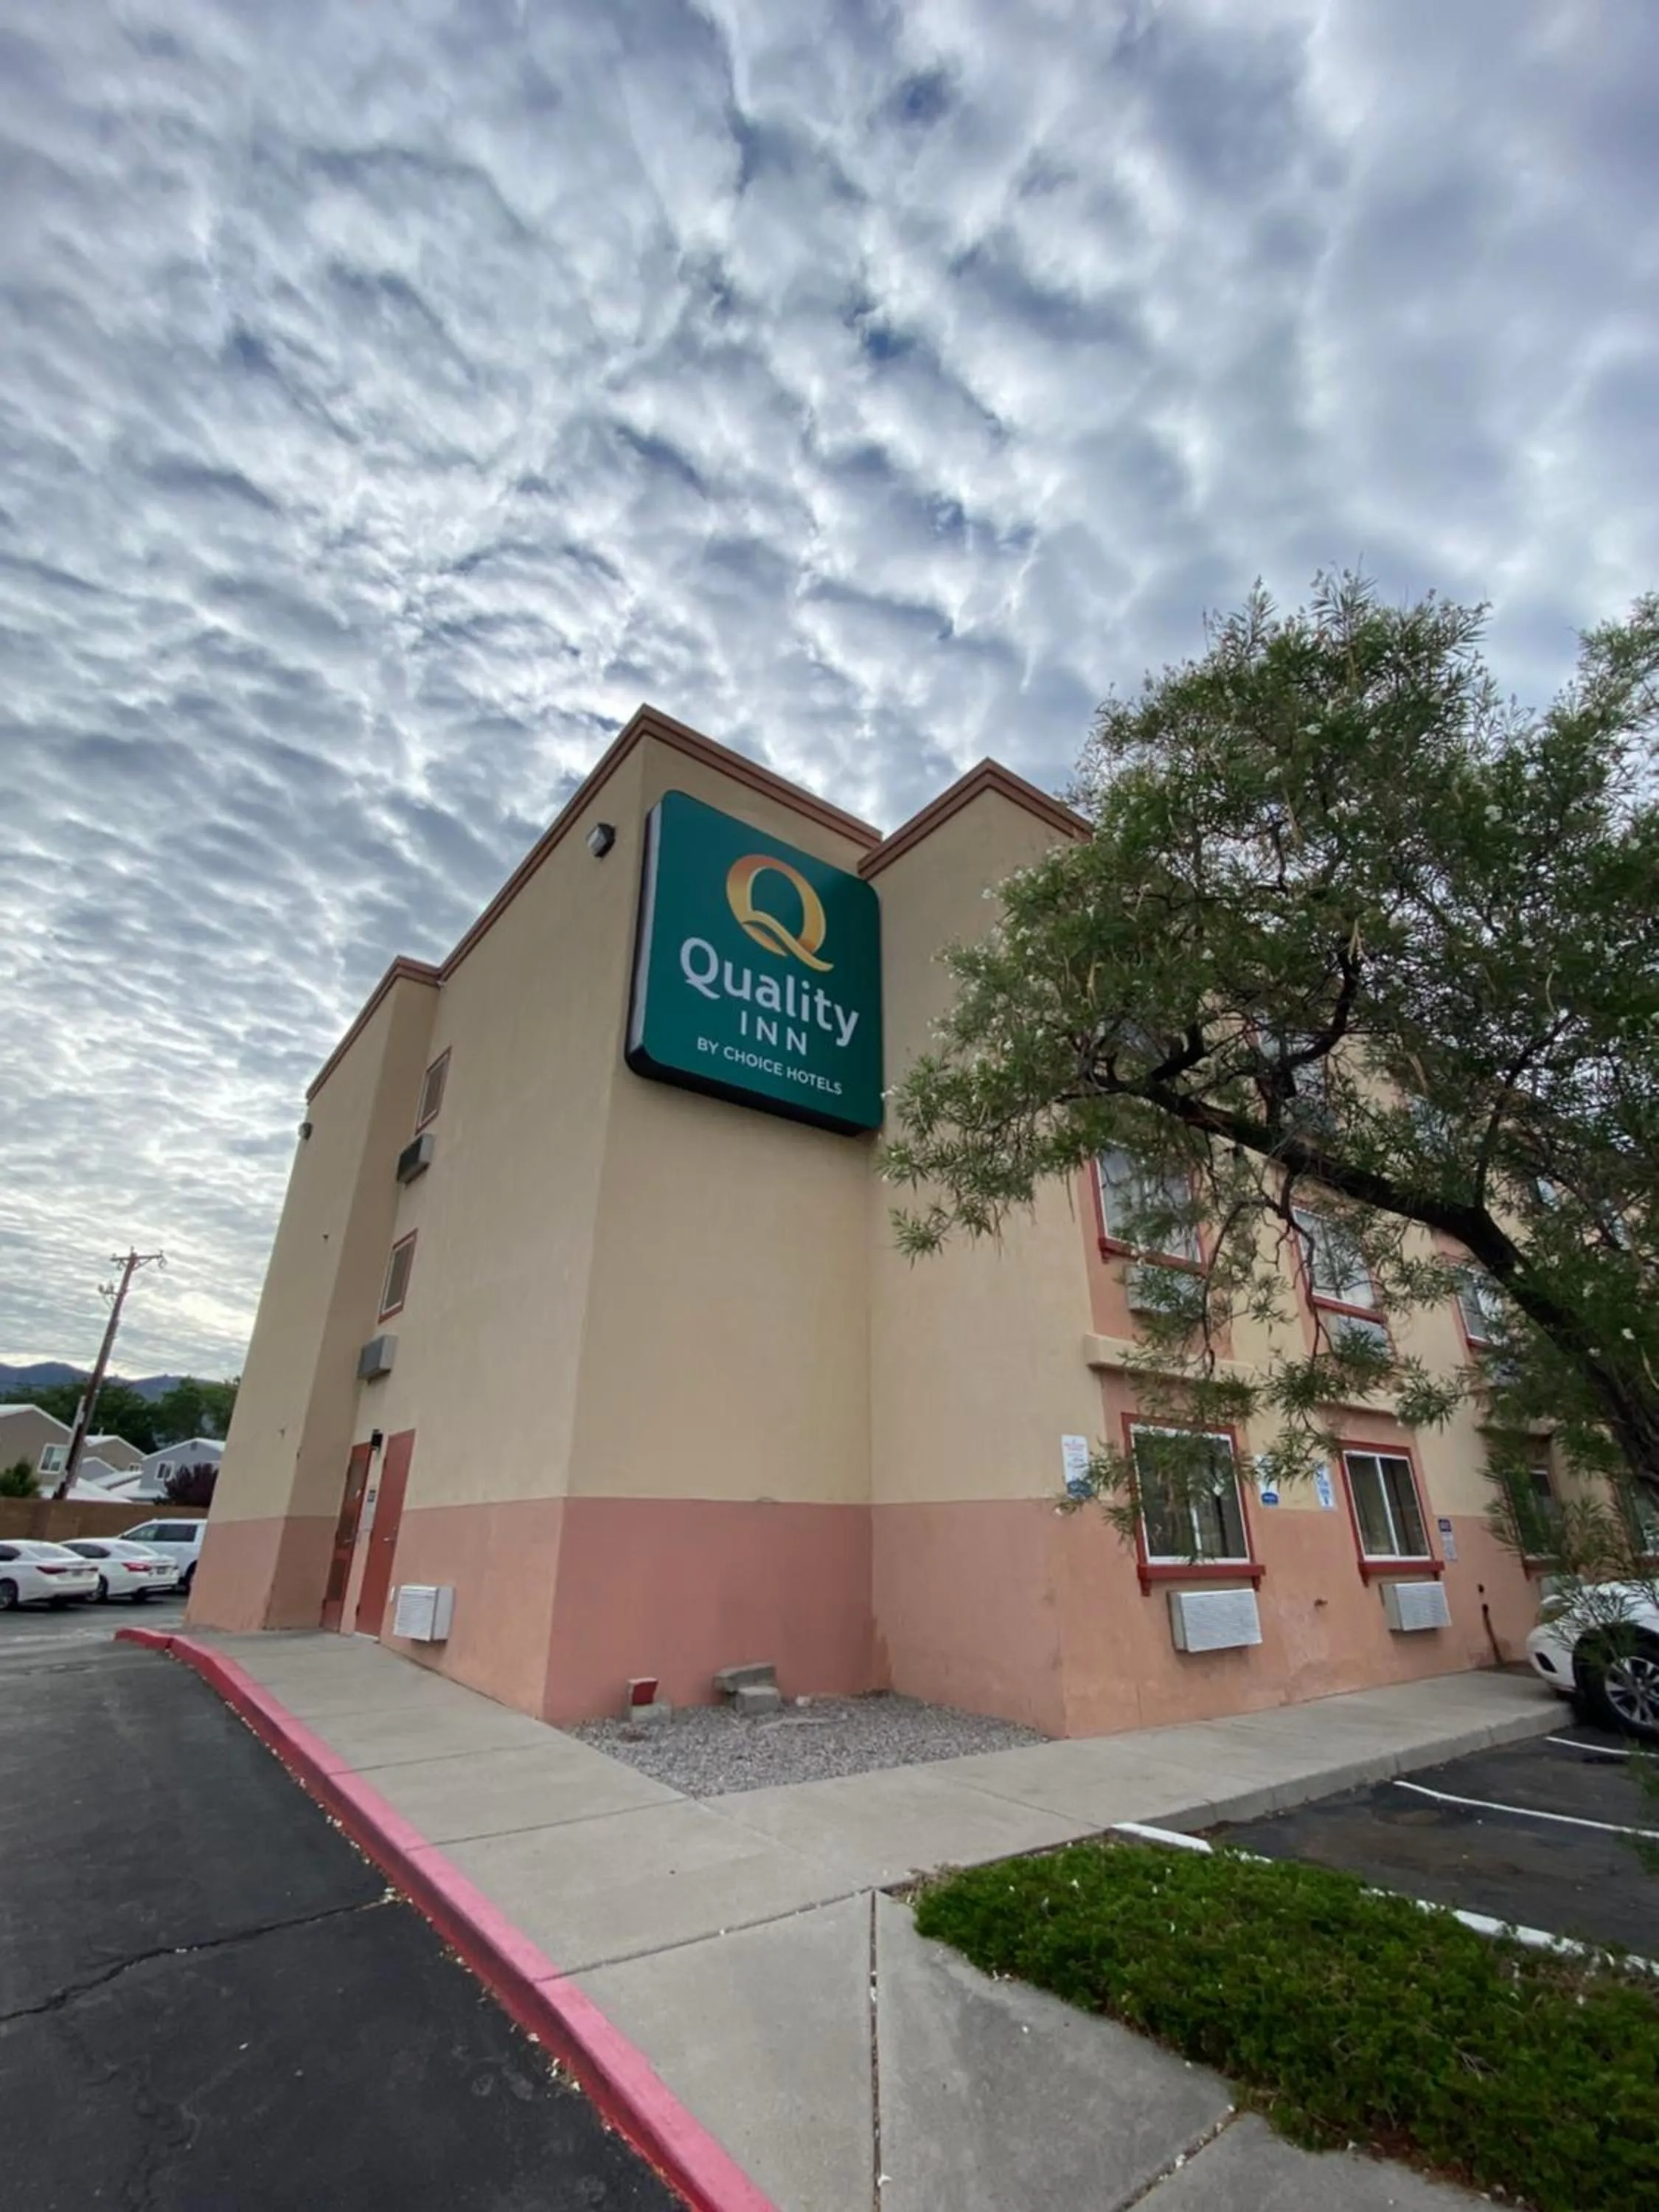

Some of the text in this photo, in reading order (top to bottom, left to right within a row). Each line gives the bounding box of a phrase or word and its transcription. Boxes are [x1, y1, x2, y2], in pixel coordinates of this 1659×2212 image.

[726, 854, 834, 972] Q
[680, 936, 860, 1047] Quality
[740, 1010, 807, 1056] INN
[697, 1037, 843, 1095] BY CHOICE HOTELS
